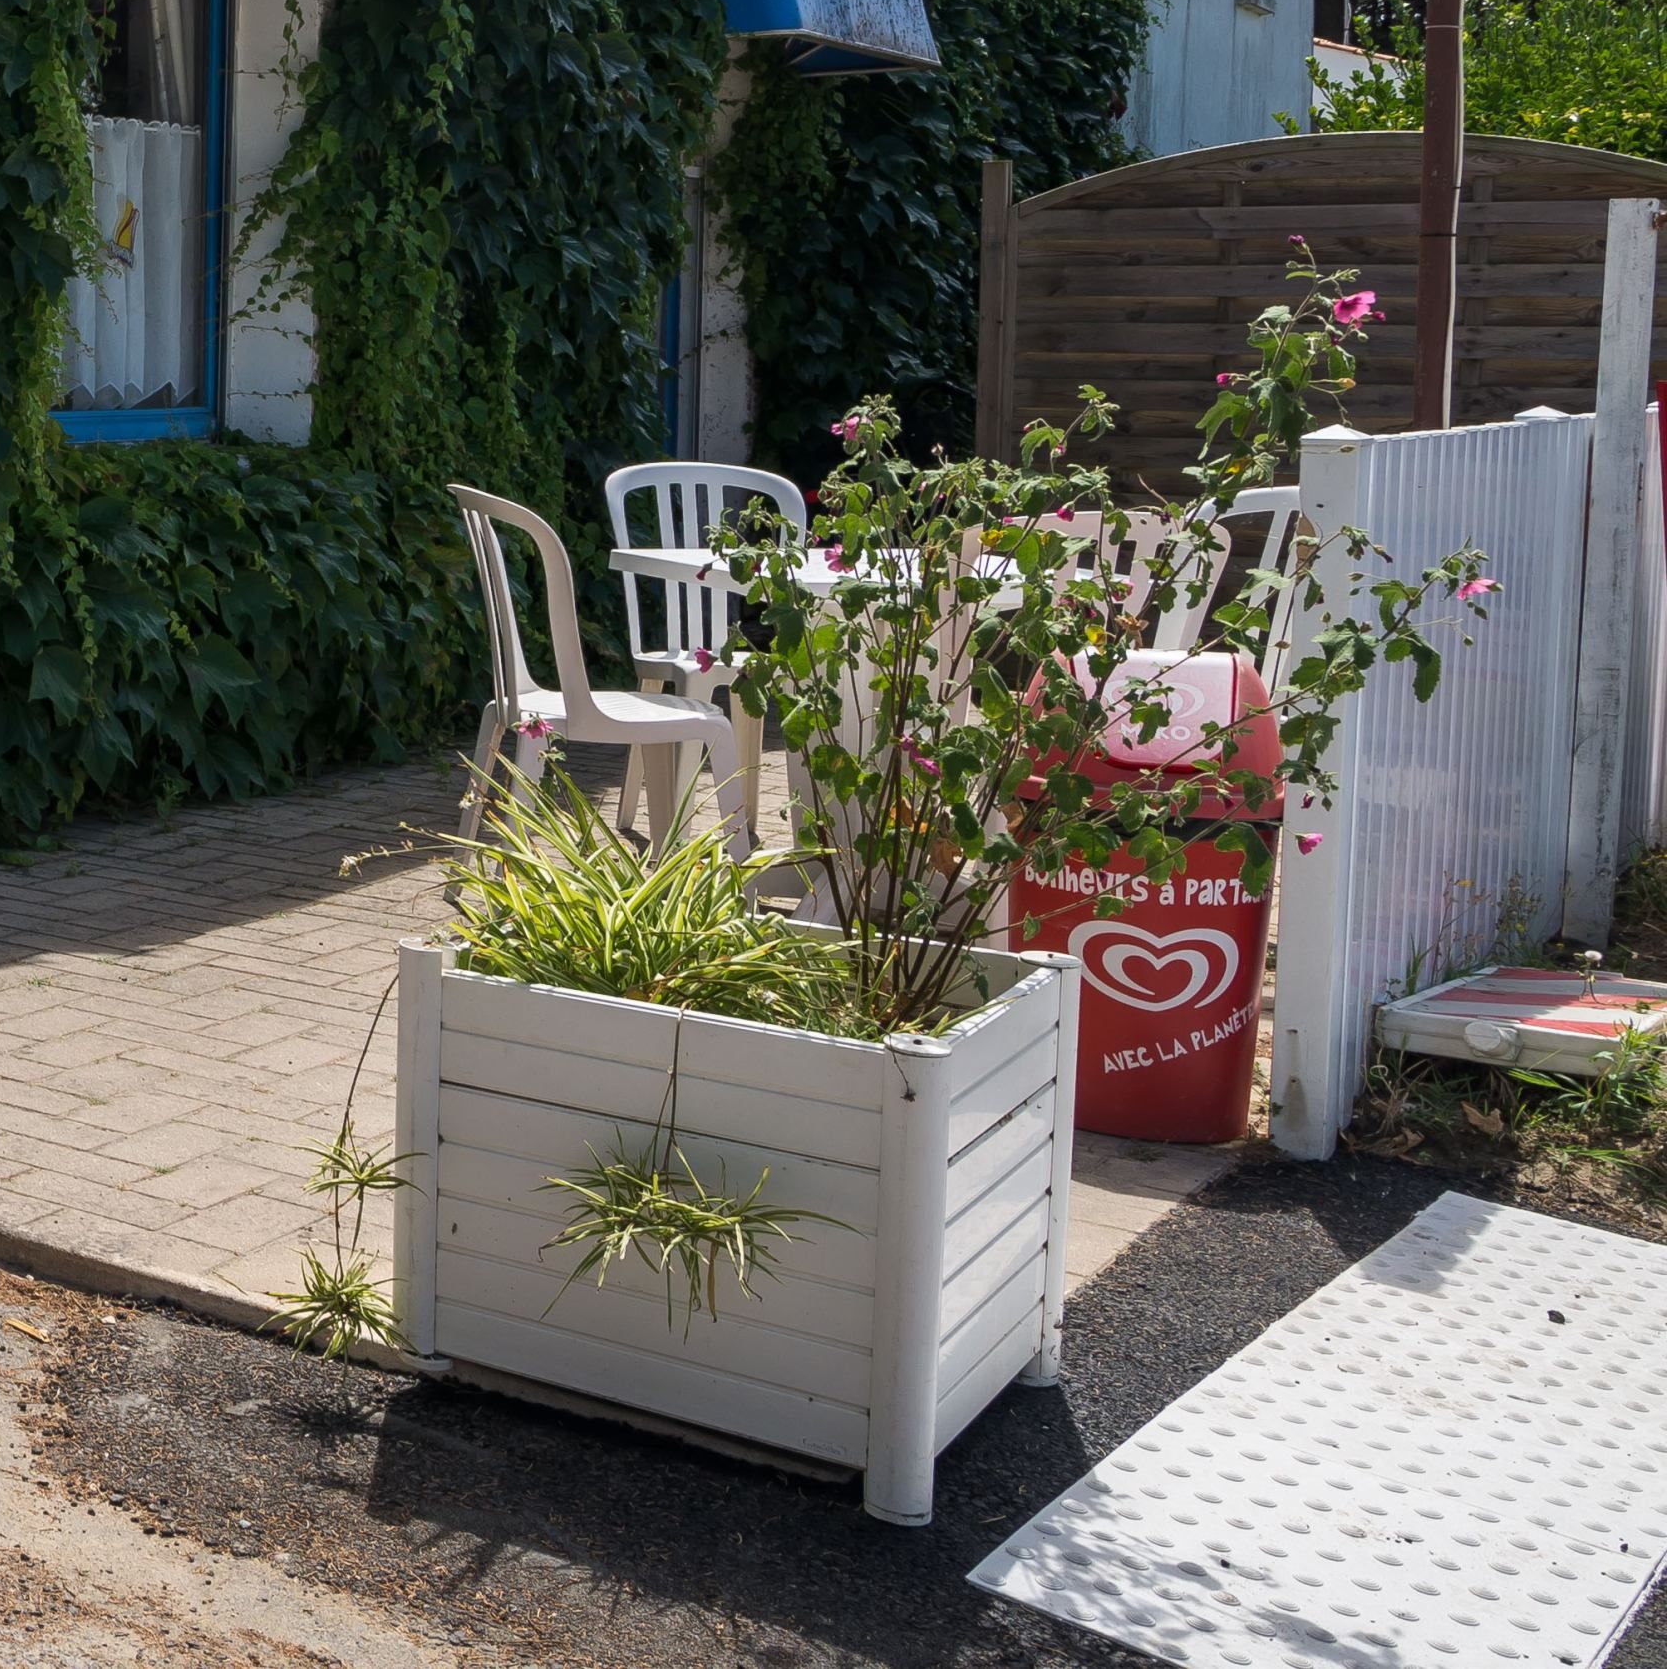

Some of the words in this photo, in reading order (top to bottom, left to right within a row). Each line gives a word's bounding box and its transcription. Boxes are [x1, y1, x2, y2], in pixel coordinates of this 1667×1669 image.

[1120, 722, 1192, 742] MKO
[1103, 1046, 1154, 1074] AVEC
[1160, 1039, 1188, 1062] LA
